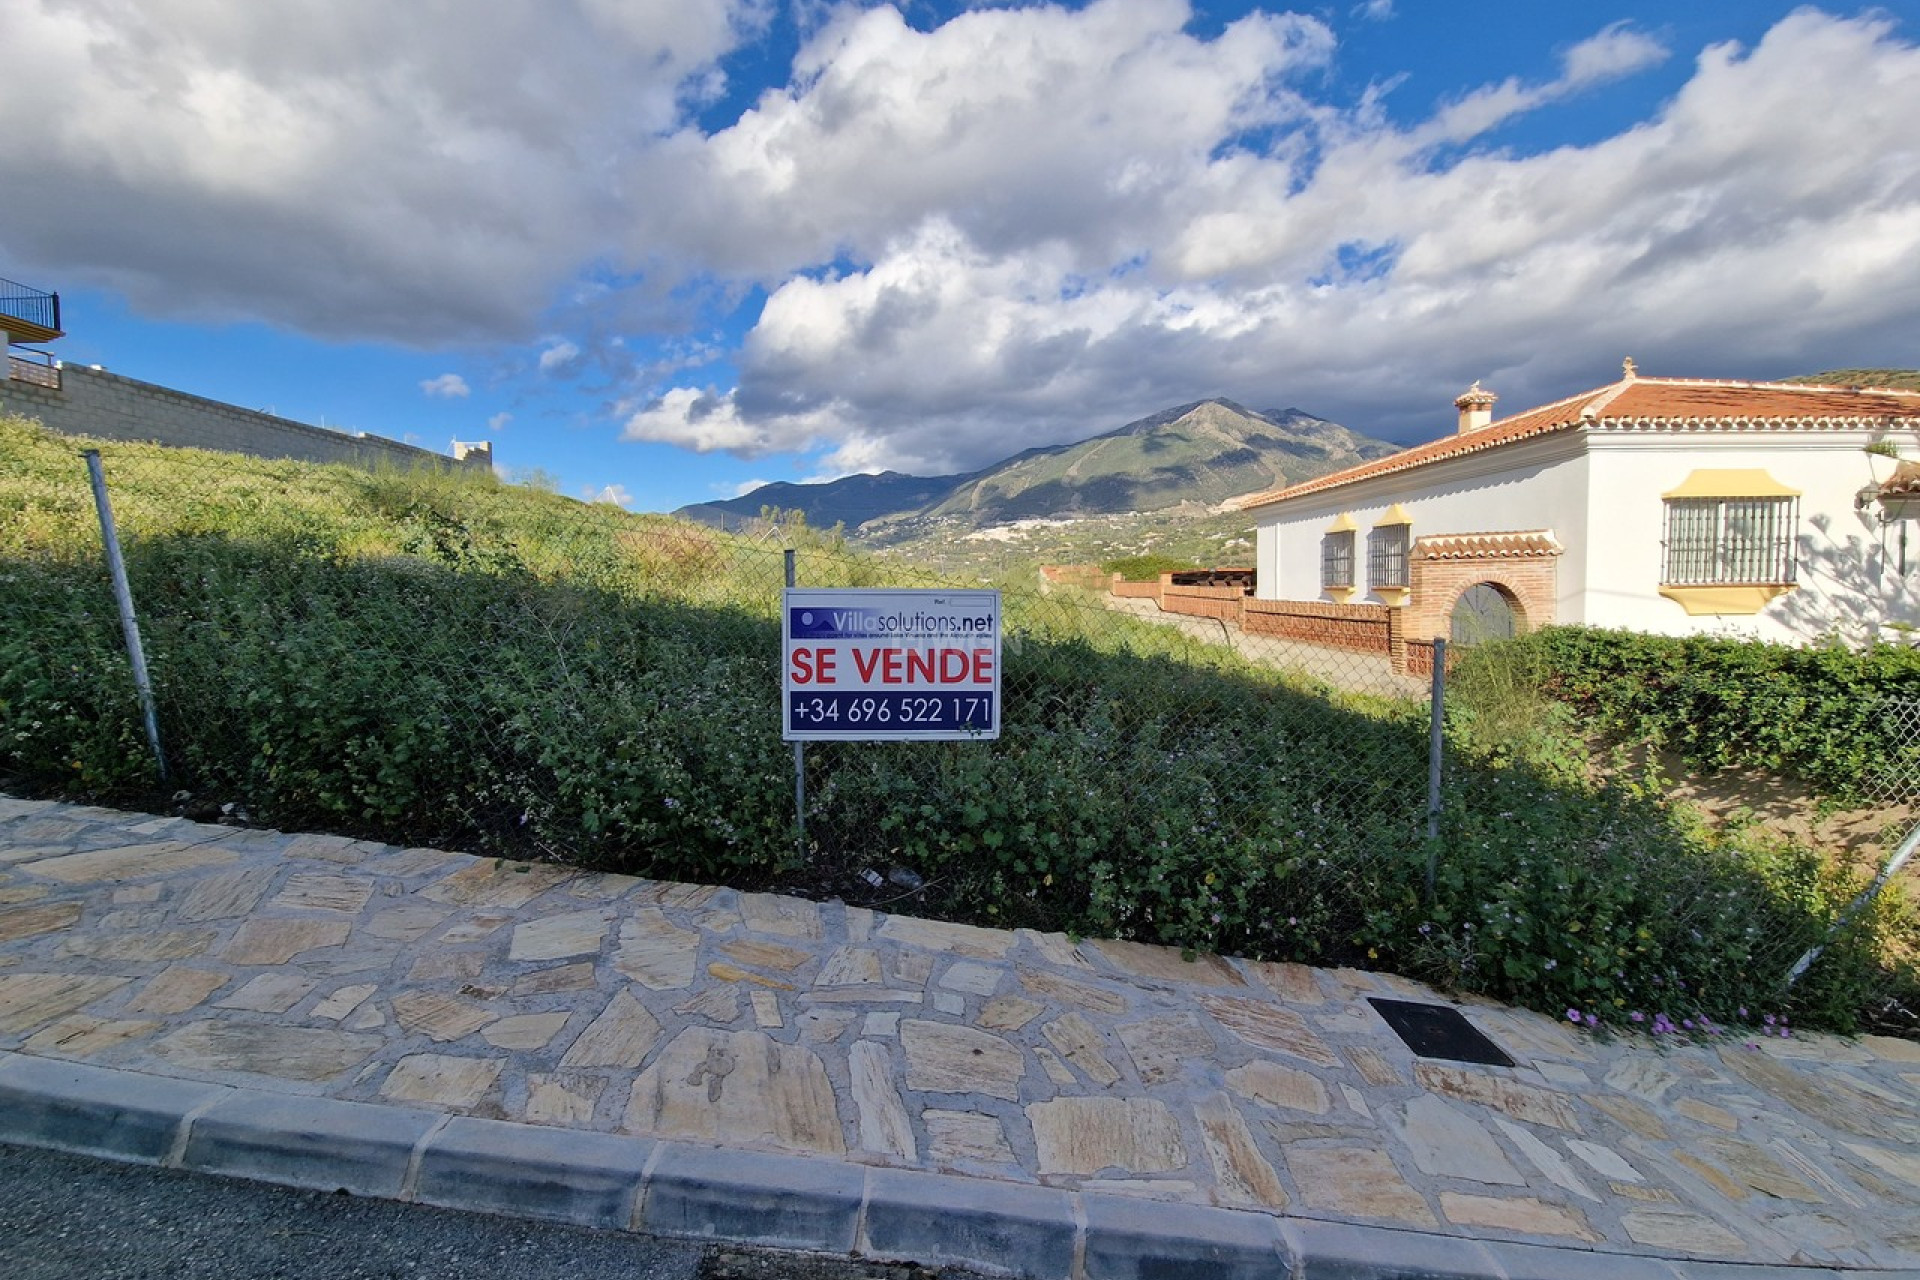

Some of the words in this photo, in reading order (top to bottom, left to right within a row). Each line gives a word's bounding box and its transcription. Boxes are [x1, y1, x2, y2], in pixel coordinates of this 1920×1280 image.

[833, 611, 993, 632] Villasolutions.net
[791, 647, 836, 684] SE
[851, 648, 993, 683] VENDE
[794, 698, 840, 722] +34
[848, 698, 891, 722] 696
[900, 698, 943, 722] 522
[953, 698, 989, 722] 171
